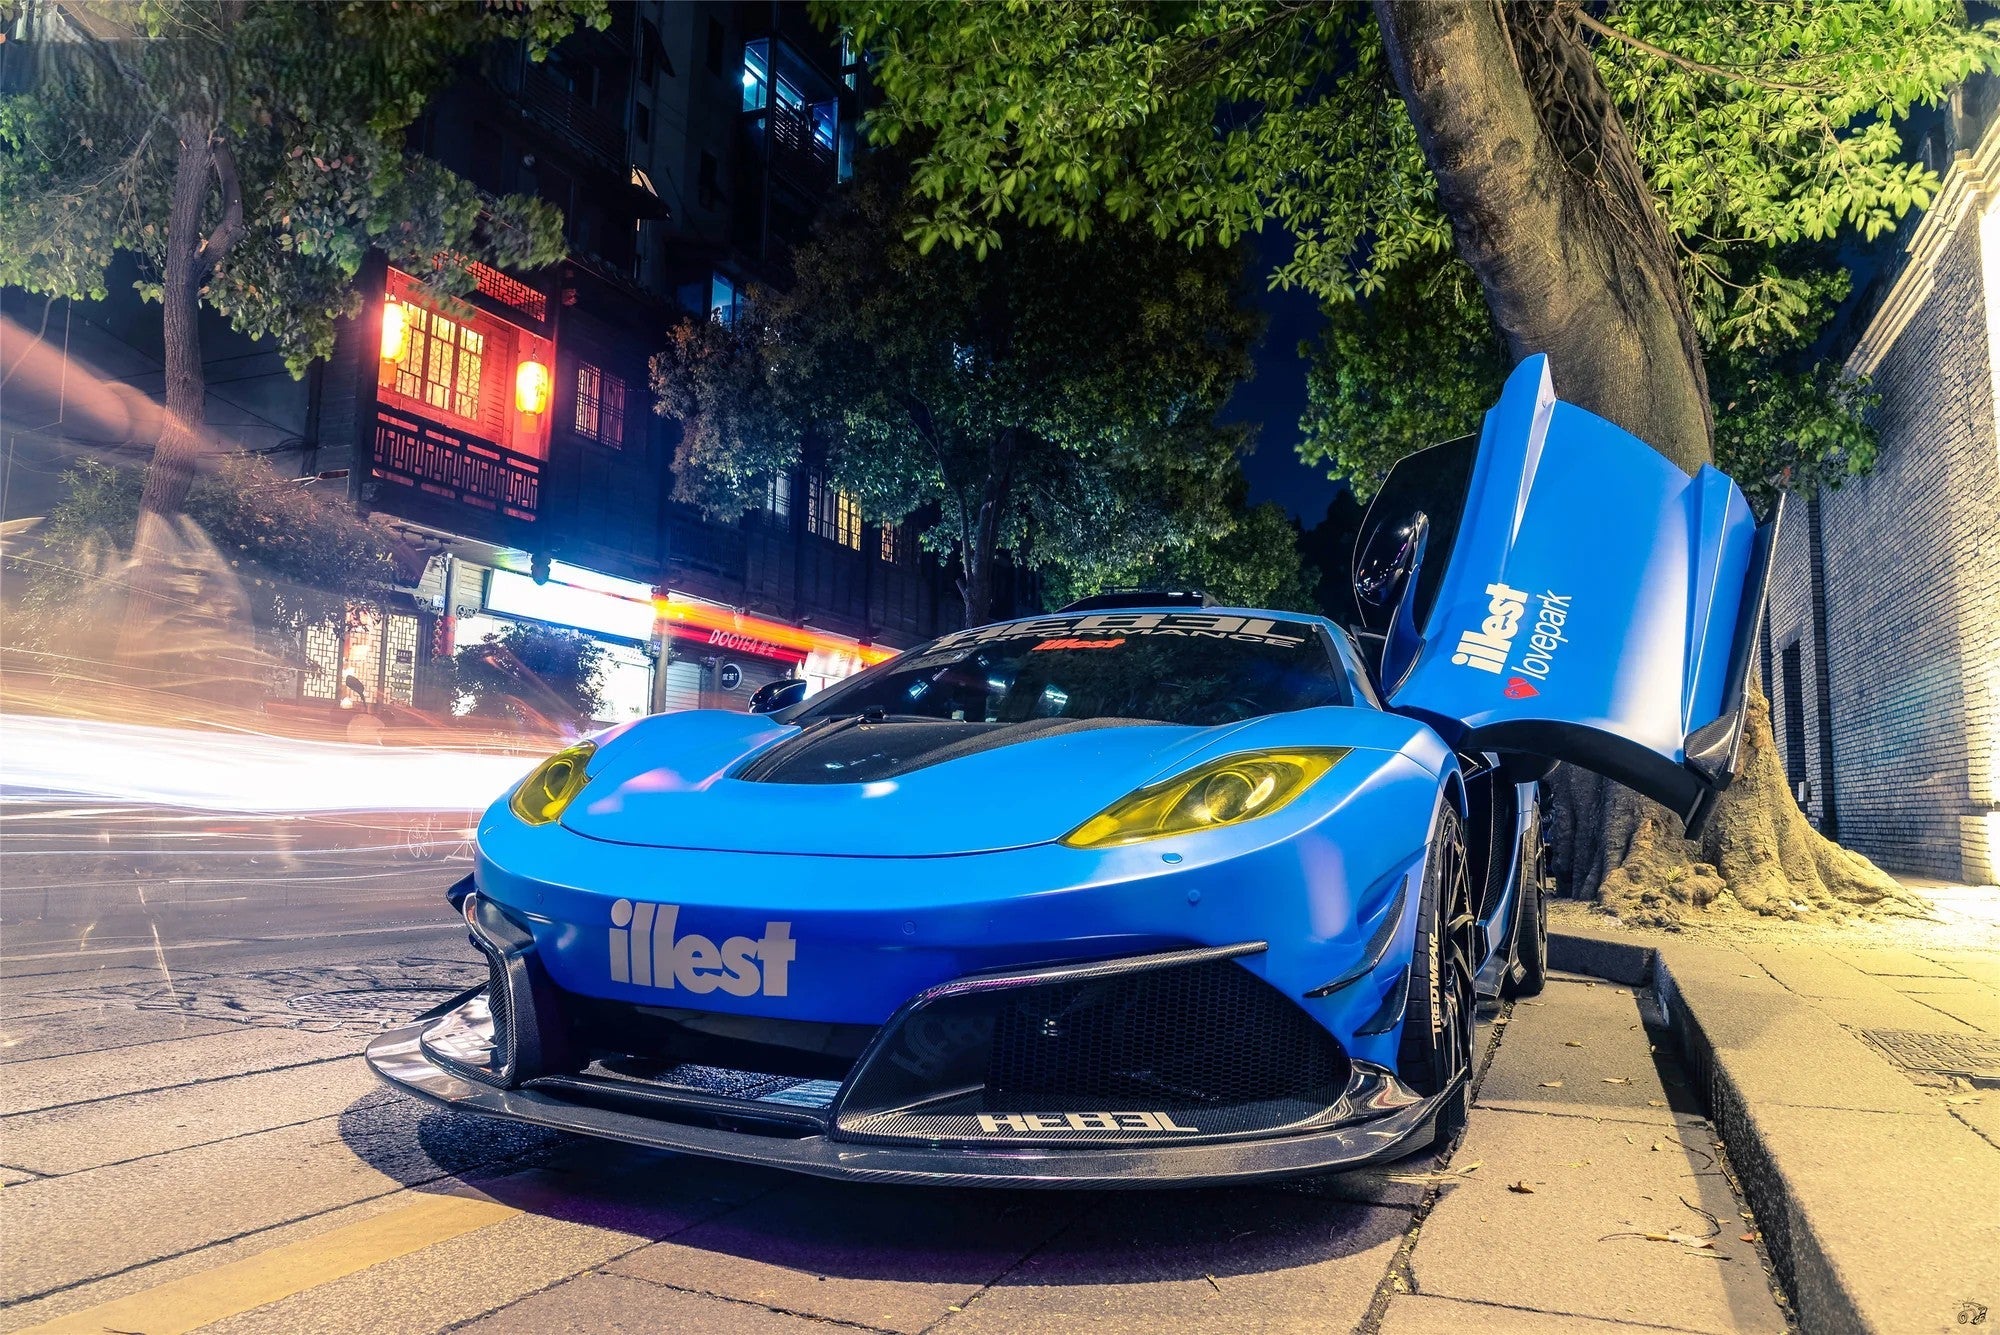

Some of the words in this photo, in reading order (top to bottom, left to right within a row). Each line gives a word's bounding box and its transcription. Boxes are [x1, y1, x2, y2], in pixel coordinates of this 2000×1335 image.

[922, 628, 1297, 656] PERFORMANCE
[1031, 637, 1127, 651] illest
[1451, 582, 1529, 675] illest
[1511, 589, 1572, 680] lovepark
[608, 898, 797, 997] illest
[1428, 910, 1443, 1050] TREDWEAR
